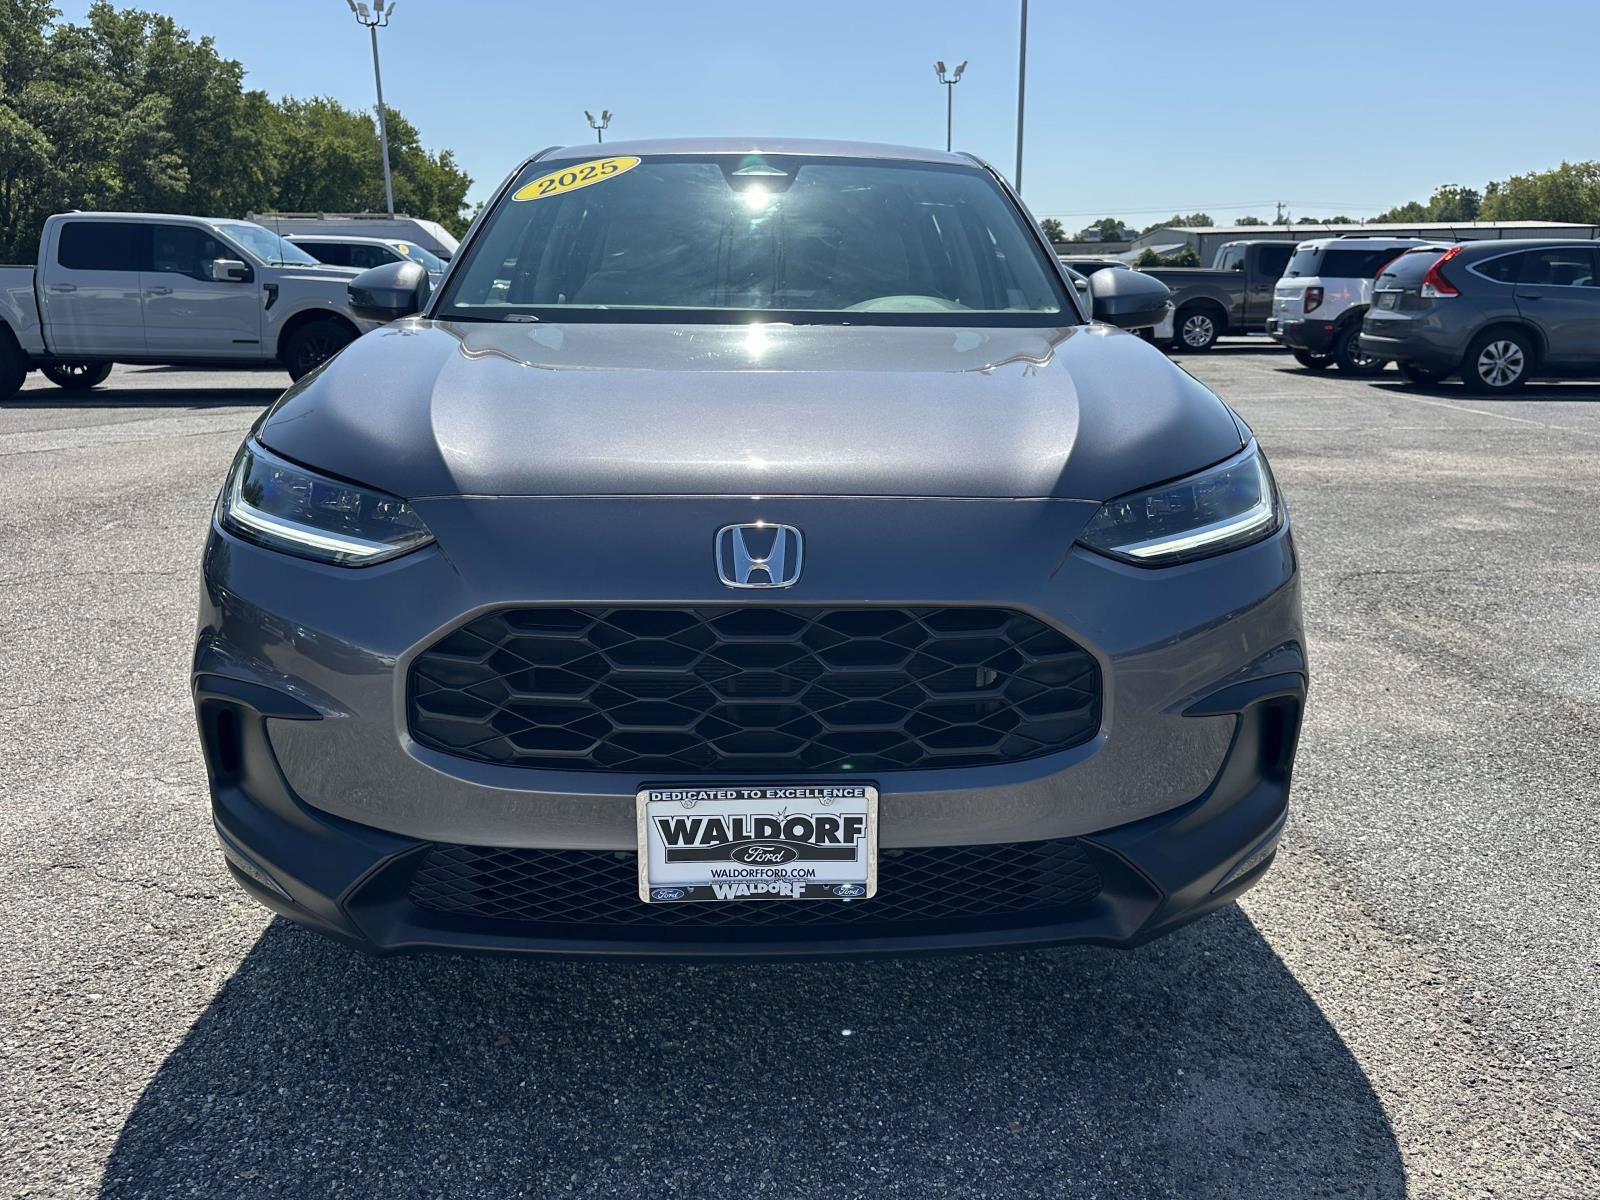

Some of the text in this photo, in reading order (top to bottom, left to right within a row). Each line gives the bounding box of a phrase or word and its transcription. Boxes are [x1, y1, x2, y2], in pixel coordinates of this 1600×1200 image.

[538, 160, 618, 195] 2025
[652, 788, 863, 801] DEDICATED TO EXCELLENCE
[657, 816, 863, 846] WALDORF
[744, 847, 784, 863] Ford
[711, 868, 815, 878] WALDORFFORD.COM
[656, 889, 680, 900] Ford
[712, 880, 806, 899] WALDORF
[839, 886, 862, 896] Ford
